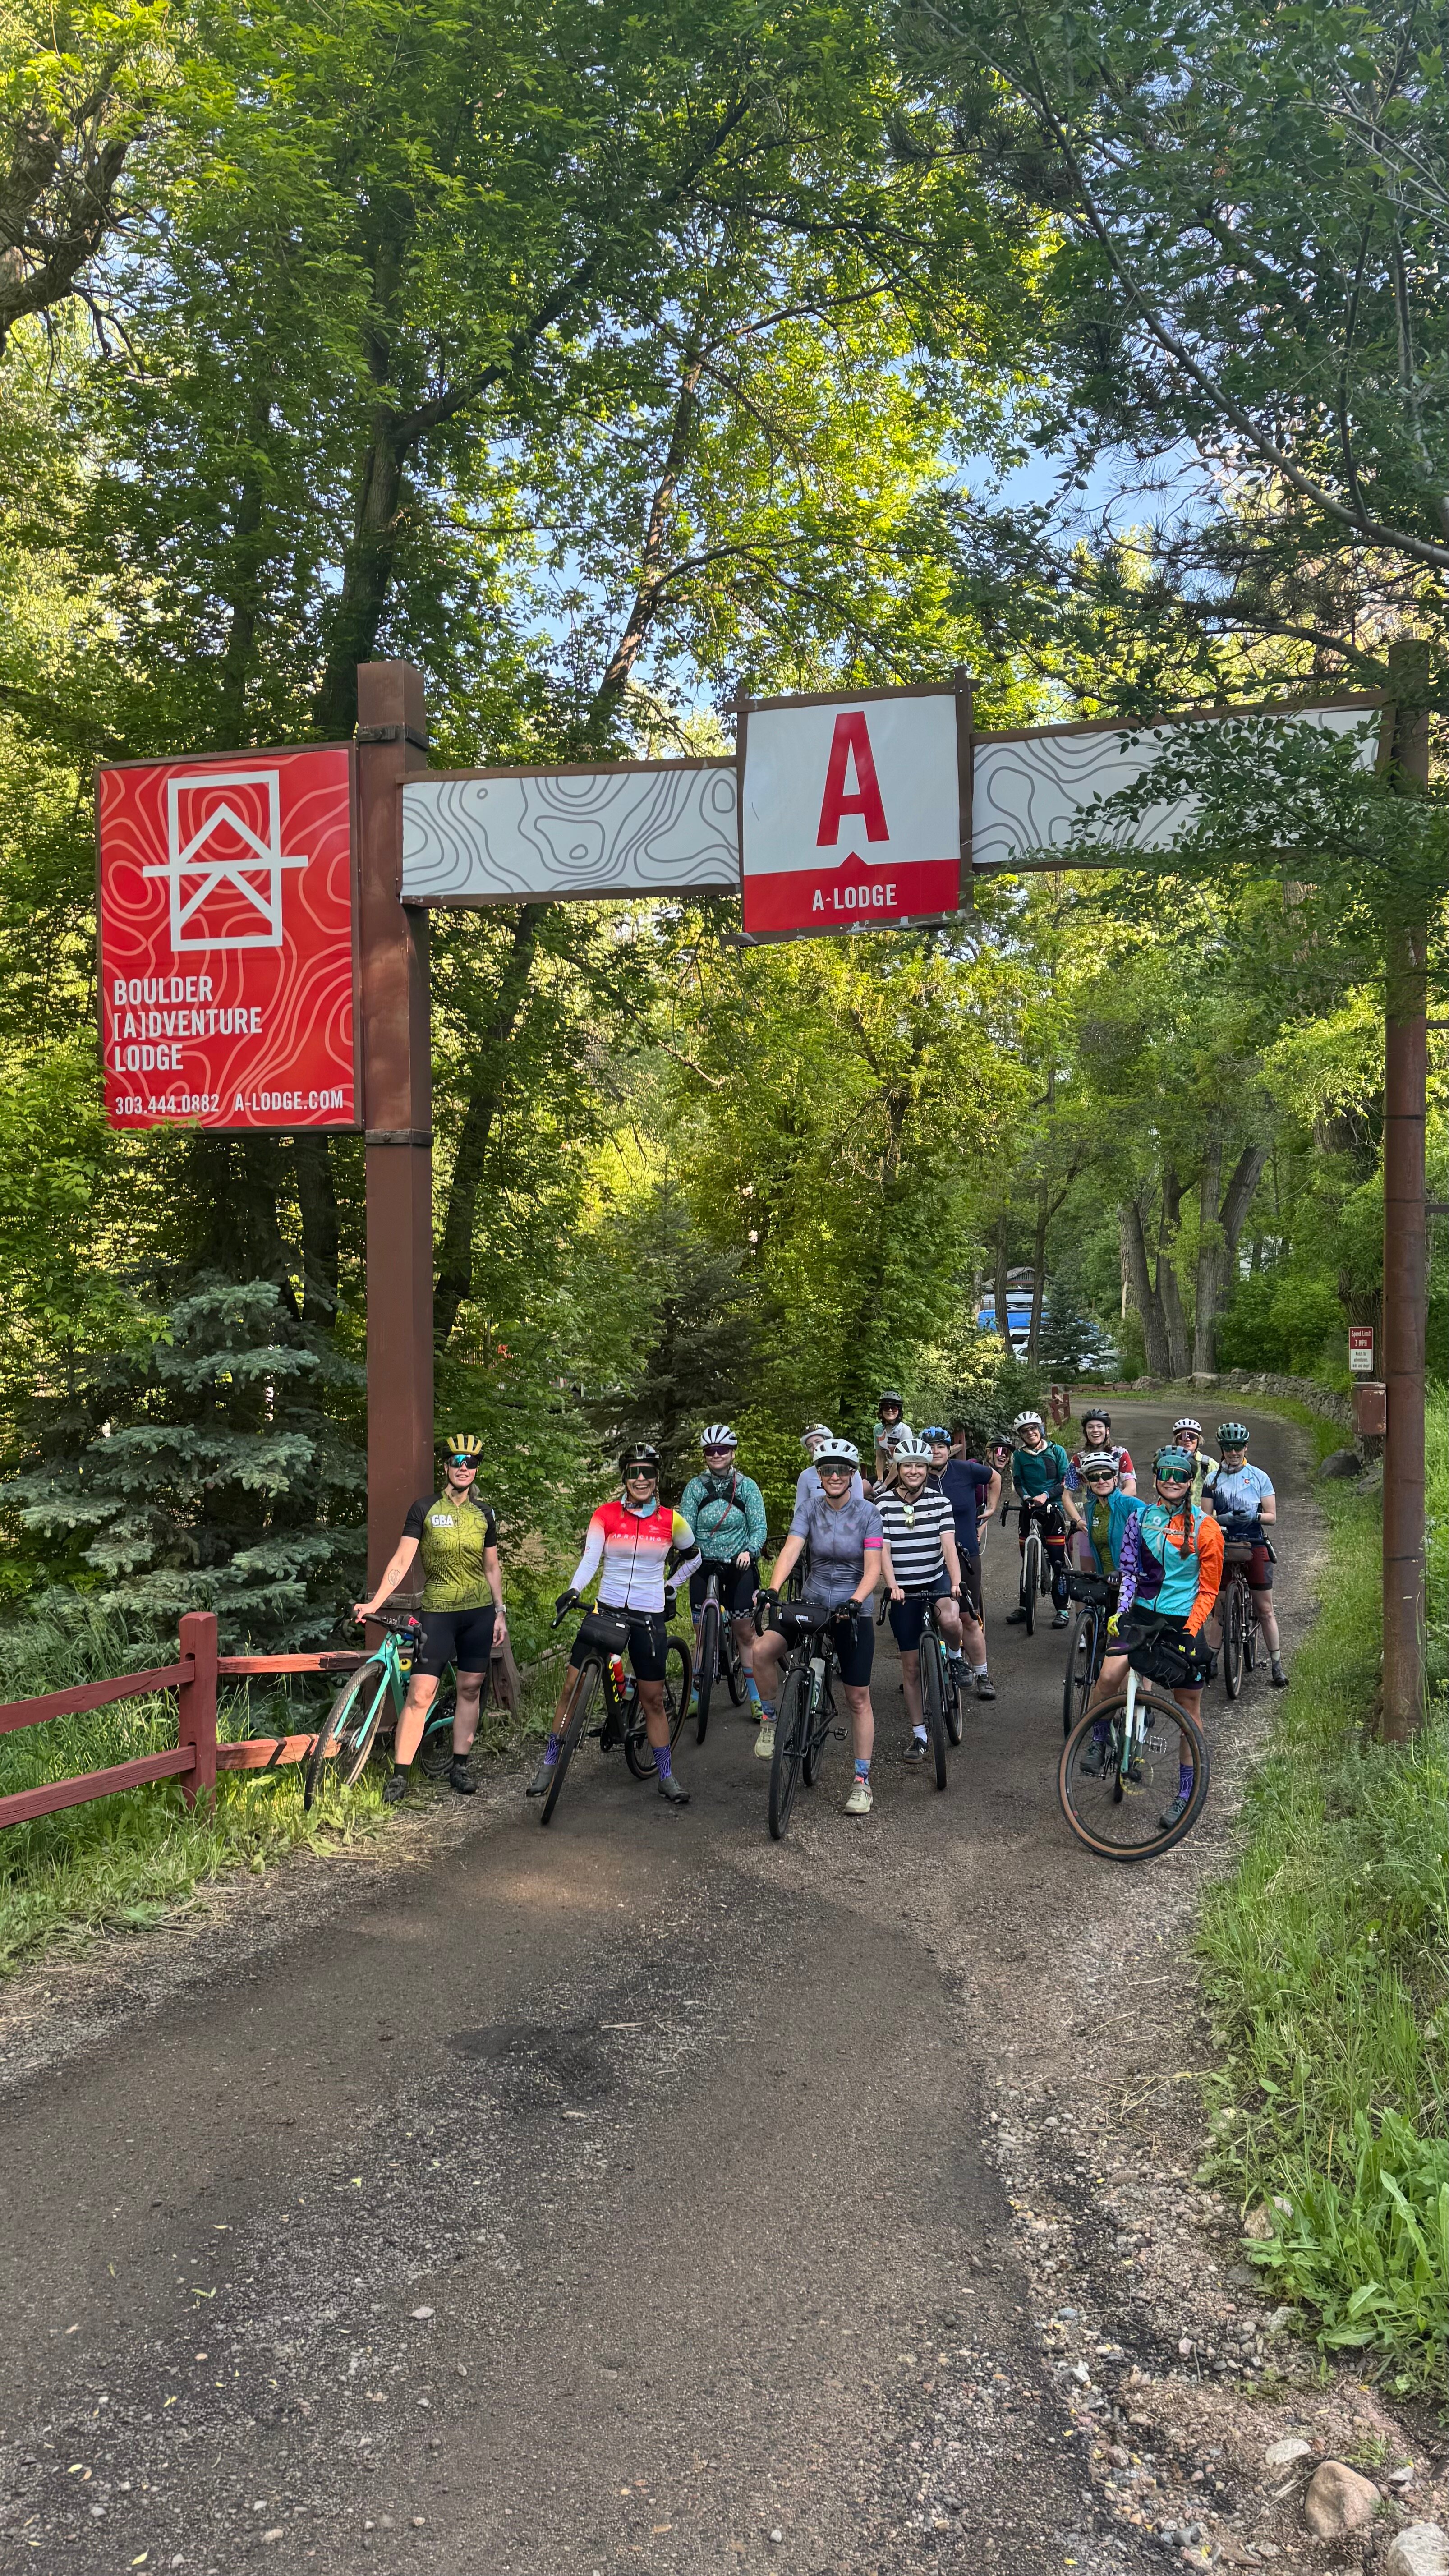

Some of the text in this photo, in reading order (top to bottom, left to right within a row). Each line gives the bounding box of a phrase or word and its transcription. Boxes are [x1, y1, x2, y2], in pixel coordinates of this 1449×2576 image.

[816, 711, 890, 846] A
[114, 975, 213, 1006] BOULDER
[114, 1007, 262, 1041] [A]DVENTURE
[115, 1044, 184, 1072] LODGE
[115, 1090, 344, 1115] 303.444.0882 A-LODGE.COM
[432, 1514, 454, 1525] GBA
